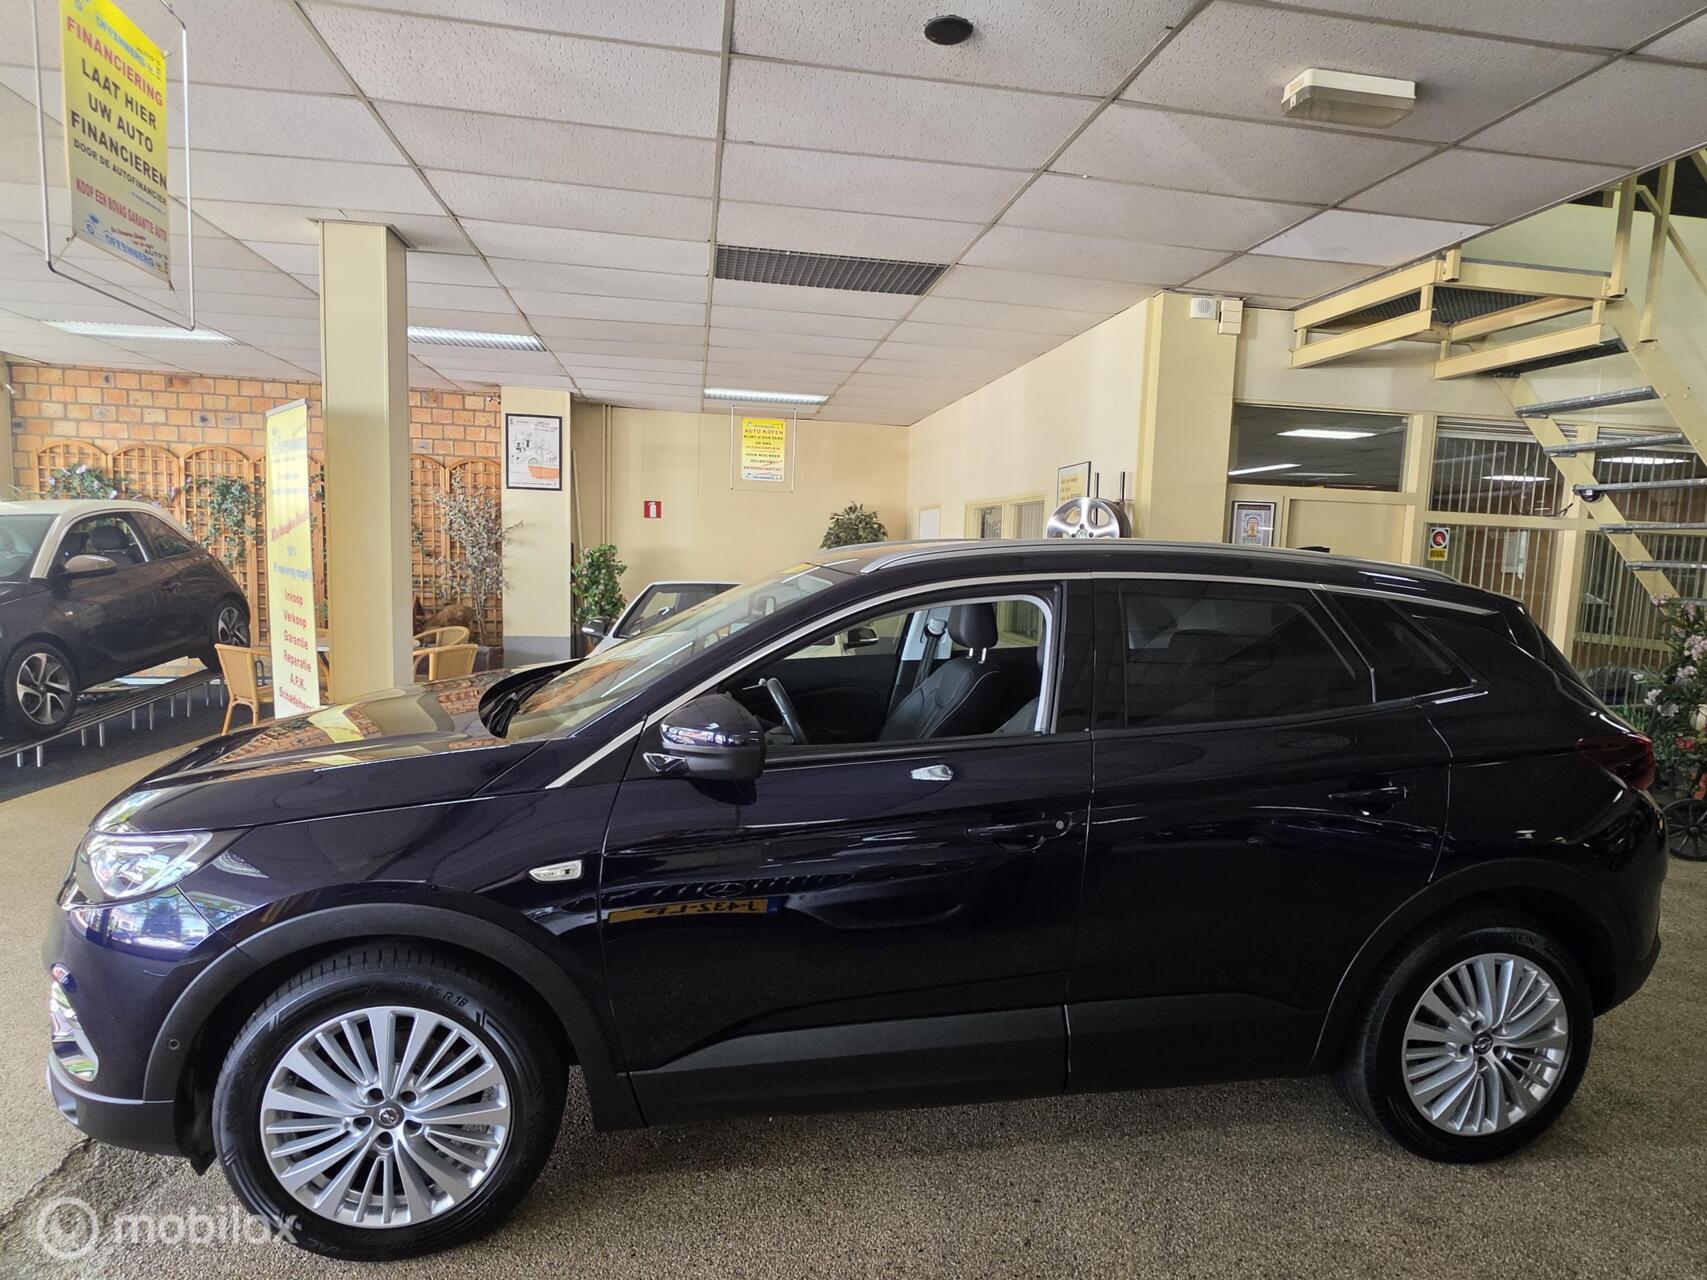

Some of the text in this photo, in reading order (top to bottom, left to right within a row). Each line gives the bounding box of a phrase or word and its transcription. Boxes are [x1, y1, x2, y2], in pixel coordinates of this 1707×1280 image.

[67, 15, 163, 107] FINANCIERING
[81, 56, 120, 100] LAAT
[125, 91, 156, 130] HIER
[88, 91, 154, 154] UW AUTO
[71, 109, 168, 191] FINANCIEREN
[74, 137, 97, 160] DOOR
[99, 154, 111, 169] DE
[112, 163, 167, 206] AUTOFINANCIER
[76, 177, 94, 200] KOOP
[95, 188, 107, 209] EEN
[108, 196, 127, 219] BOVAG
[128, 207, 155, 237] GARANTIE
[283, 609, 308, 630] Verkoop
[284, 588, 304, 607] Inkoop
[283, 649, 312, 673] Reparatie
[284, 629, 309, 650] Garantie
[454, 996, 469, 1007] 18
